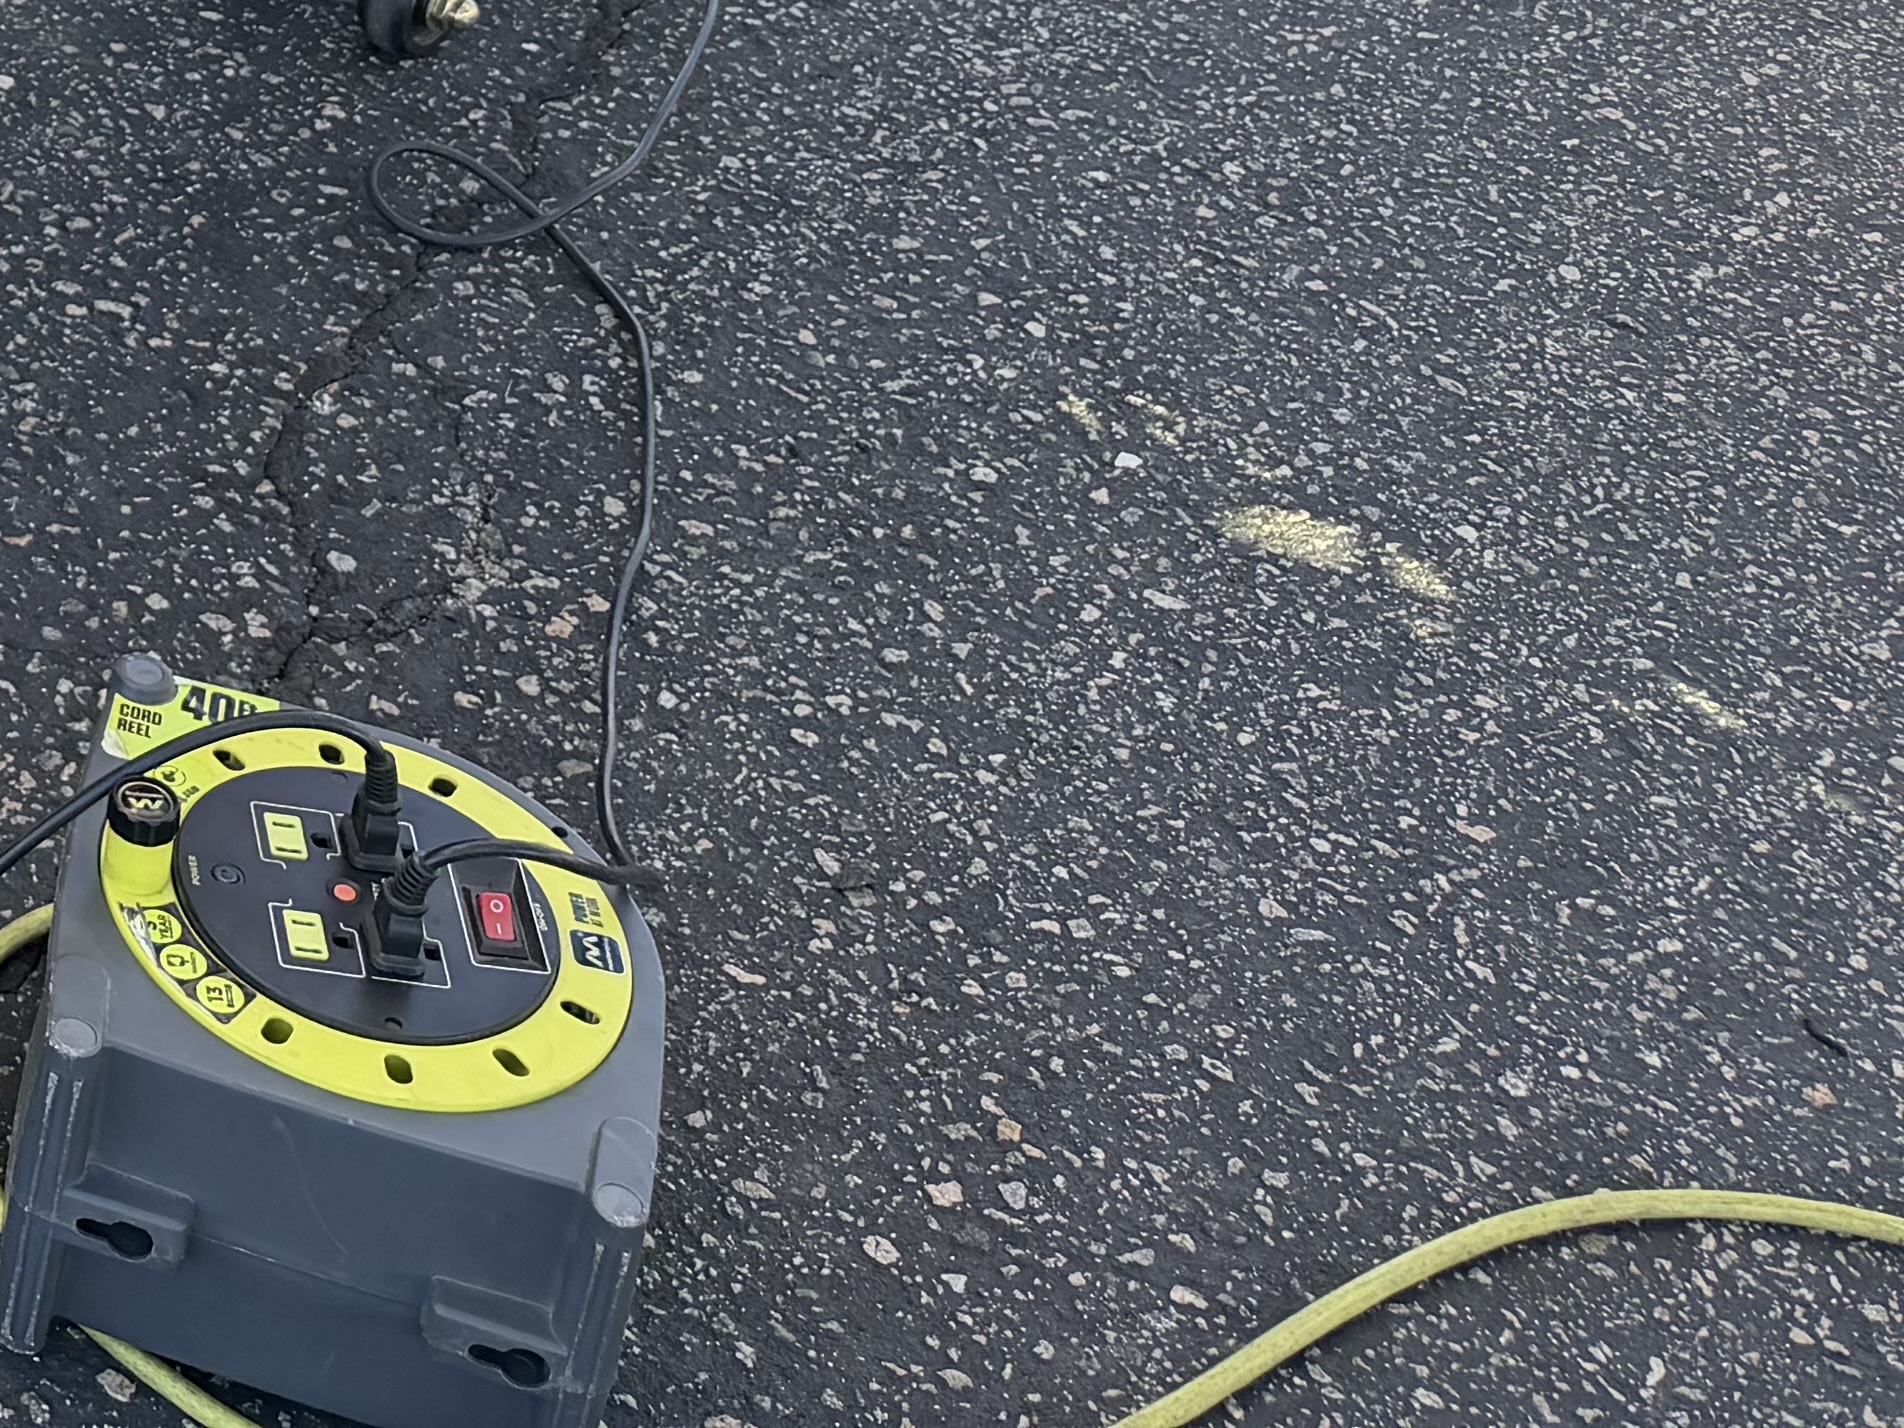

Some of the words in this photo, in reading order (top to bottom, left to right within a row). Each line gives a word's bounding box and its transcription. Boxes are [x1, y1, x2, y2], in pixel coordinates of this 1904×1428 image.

[119, 703, 162, 726] CORD
[117, 717, 152, 739] REEL
[157, 914, 168, 940] YEAR
[205, 984, 224, 1003] 13
